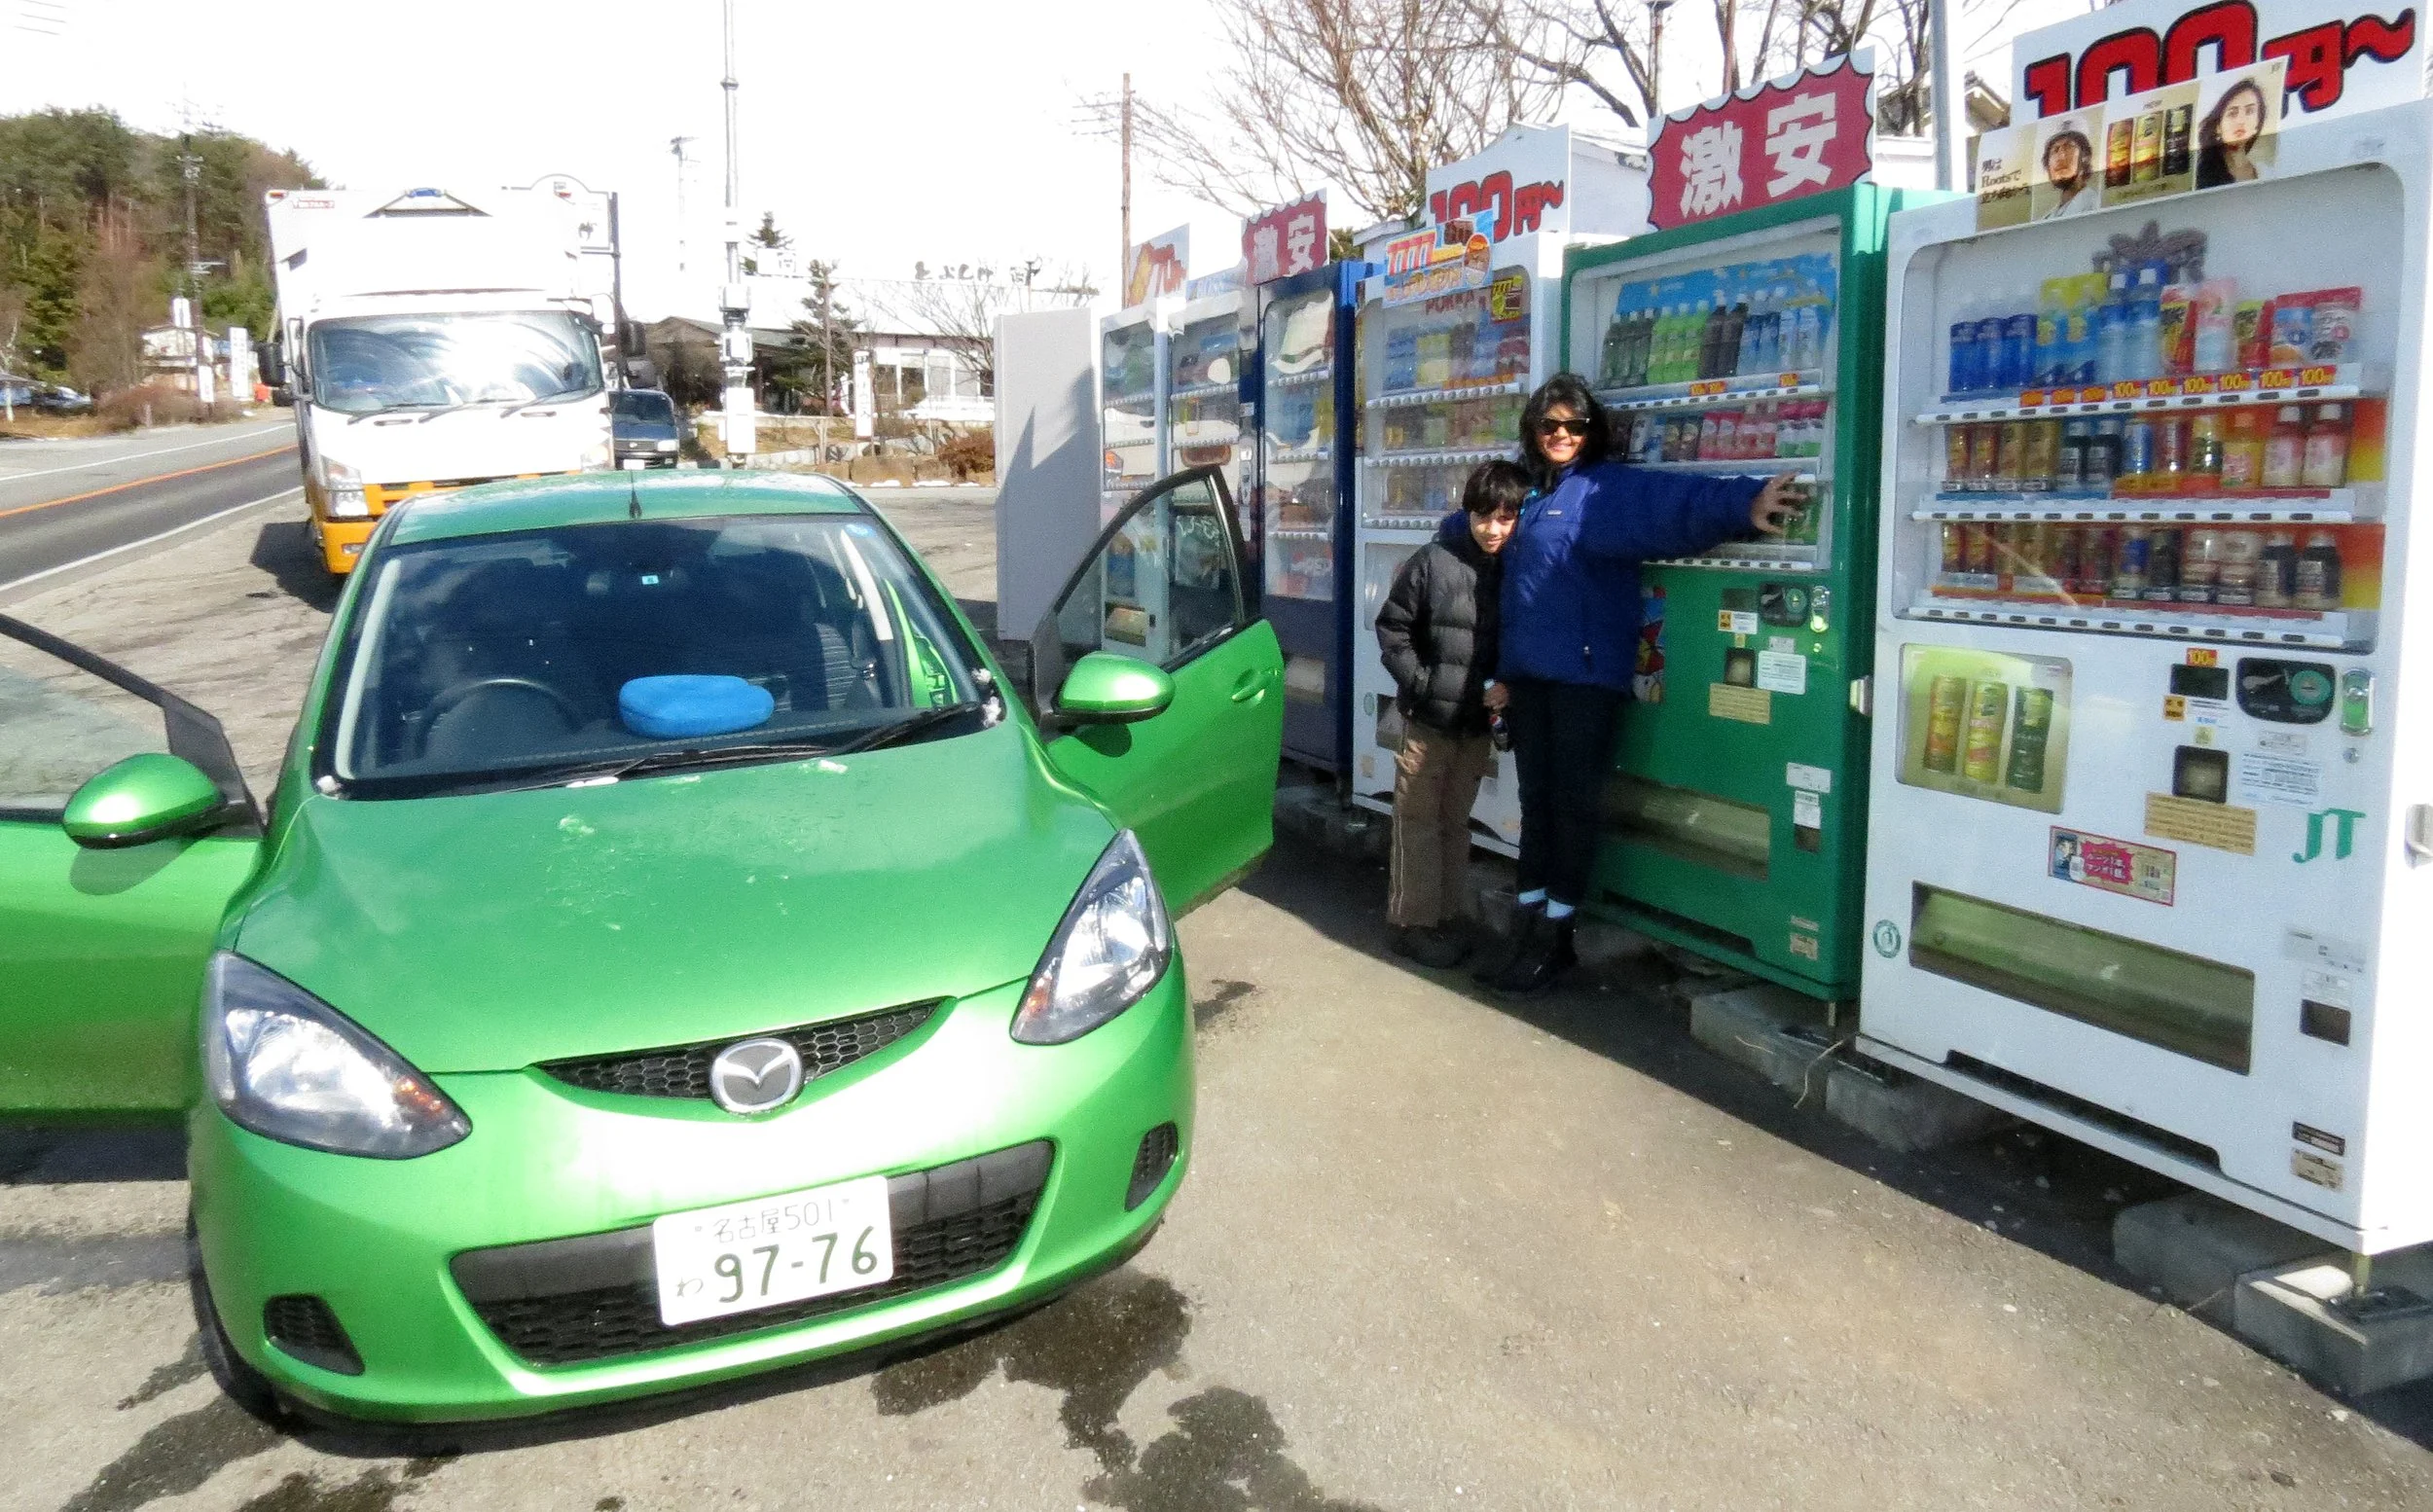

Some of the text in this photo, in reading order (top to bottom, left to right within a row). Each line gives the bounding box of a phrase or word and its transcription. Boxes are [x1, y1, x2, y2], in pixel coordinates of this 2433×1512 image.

[1680, 91, 1837, 218] 激安
[2292, 807, 2367, 864] JT
[675, 1225, 878, 1304] わ 97-76
